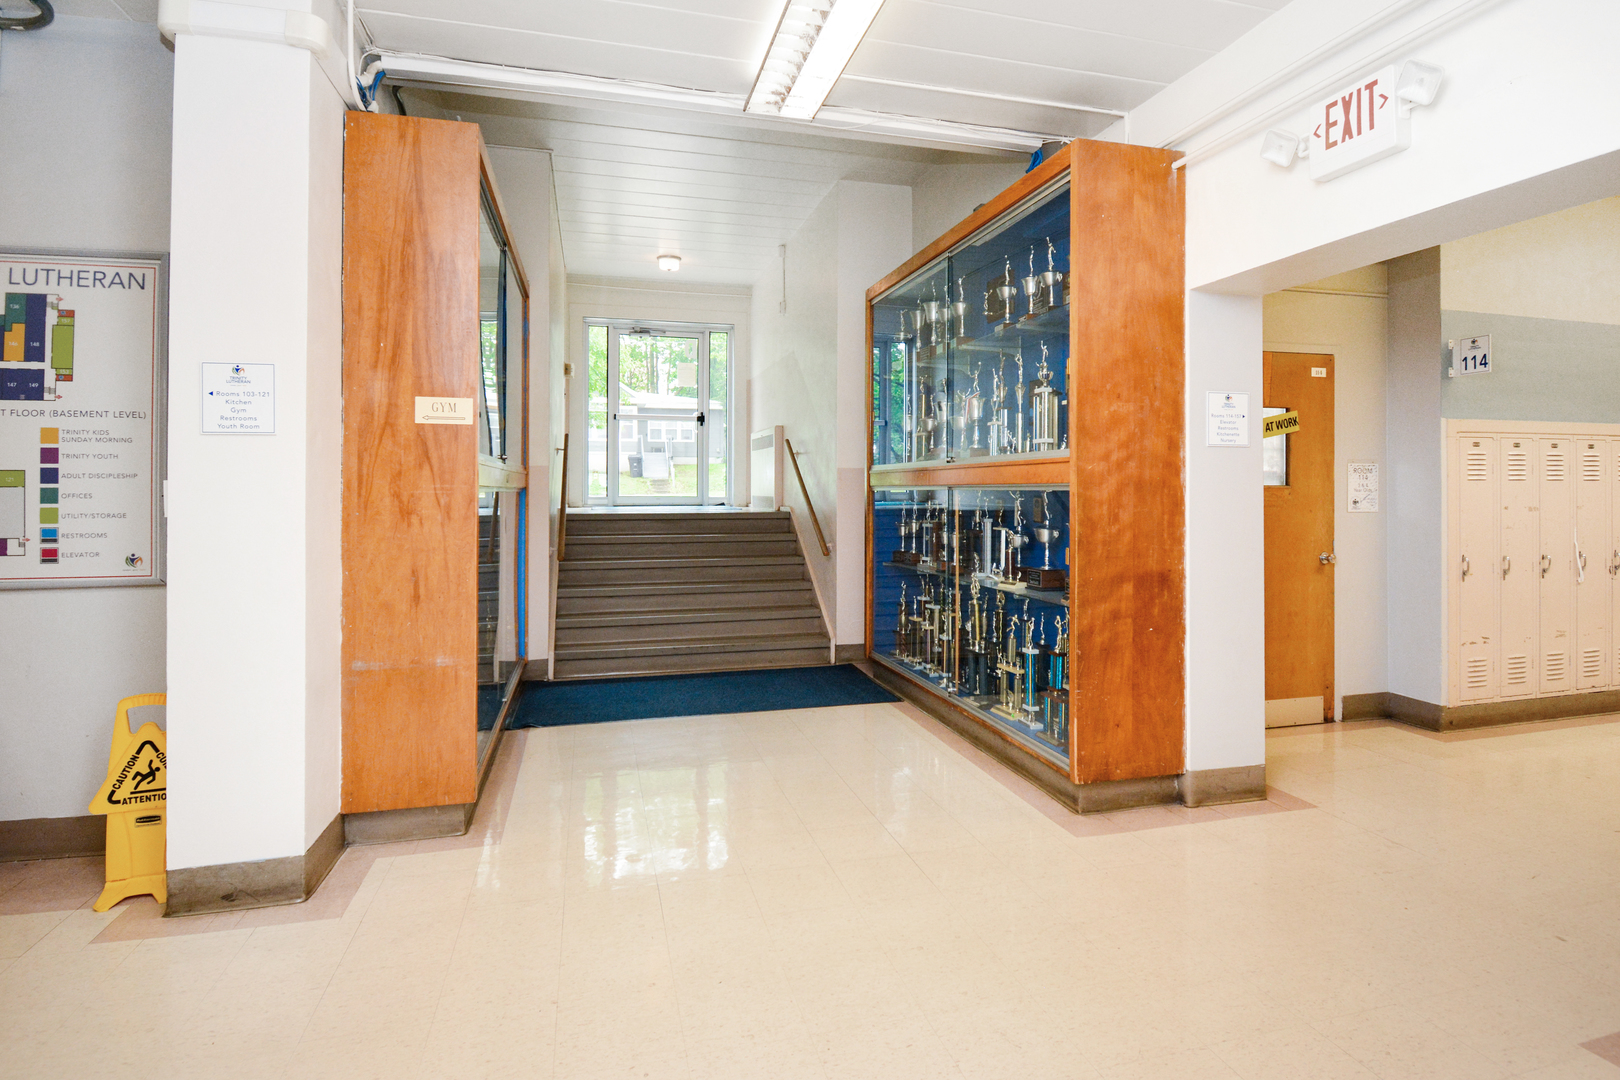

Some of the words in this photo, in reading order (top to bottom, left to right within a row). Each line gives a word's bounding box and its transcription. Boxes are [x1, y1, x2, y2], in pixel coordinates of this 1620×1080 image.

[1325, 78, 1379, 151] EXIT
[8, 267, 146, 290] LUTHERAN
[1462, 353, 1488, 371] 114
[10, 409, 45, 417] FLOOR
[49, 410, 110, 418] (BASEMENT
[113, 410, 147, 419] LEVEL)
[431, 402, 457, 413] GYM
[1265, 422, 1274, 433] AT
[1275, 416, 1299, 431] WORK
[112, 754, 140, 790] CAUTION
